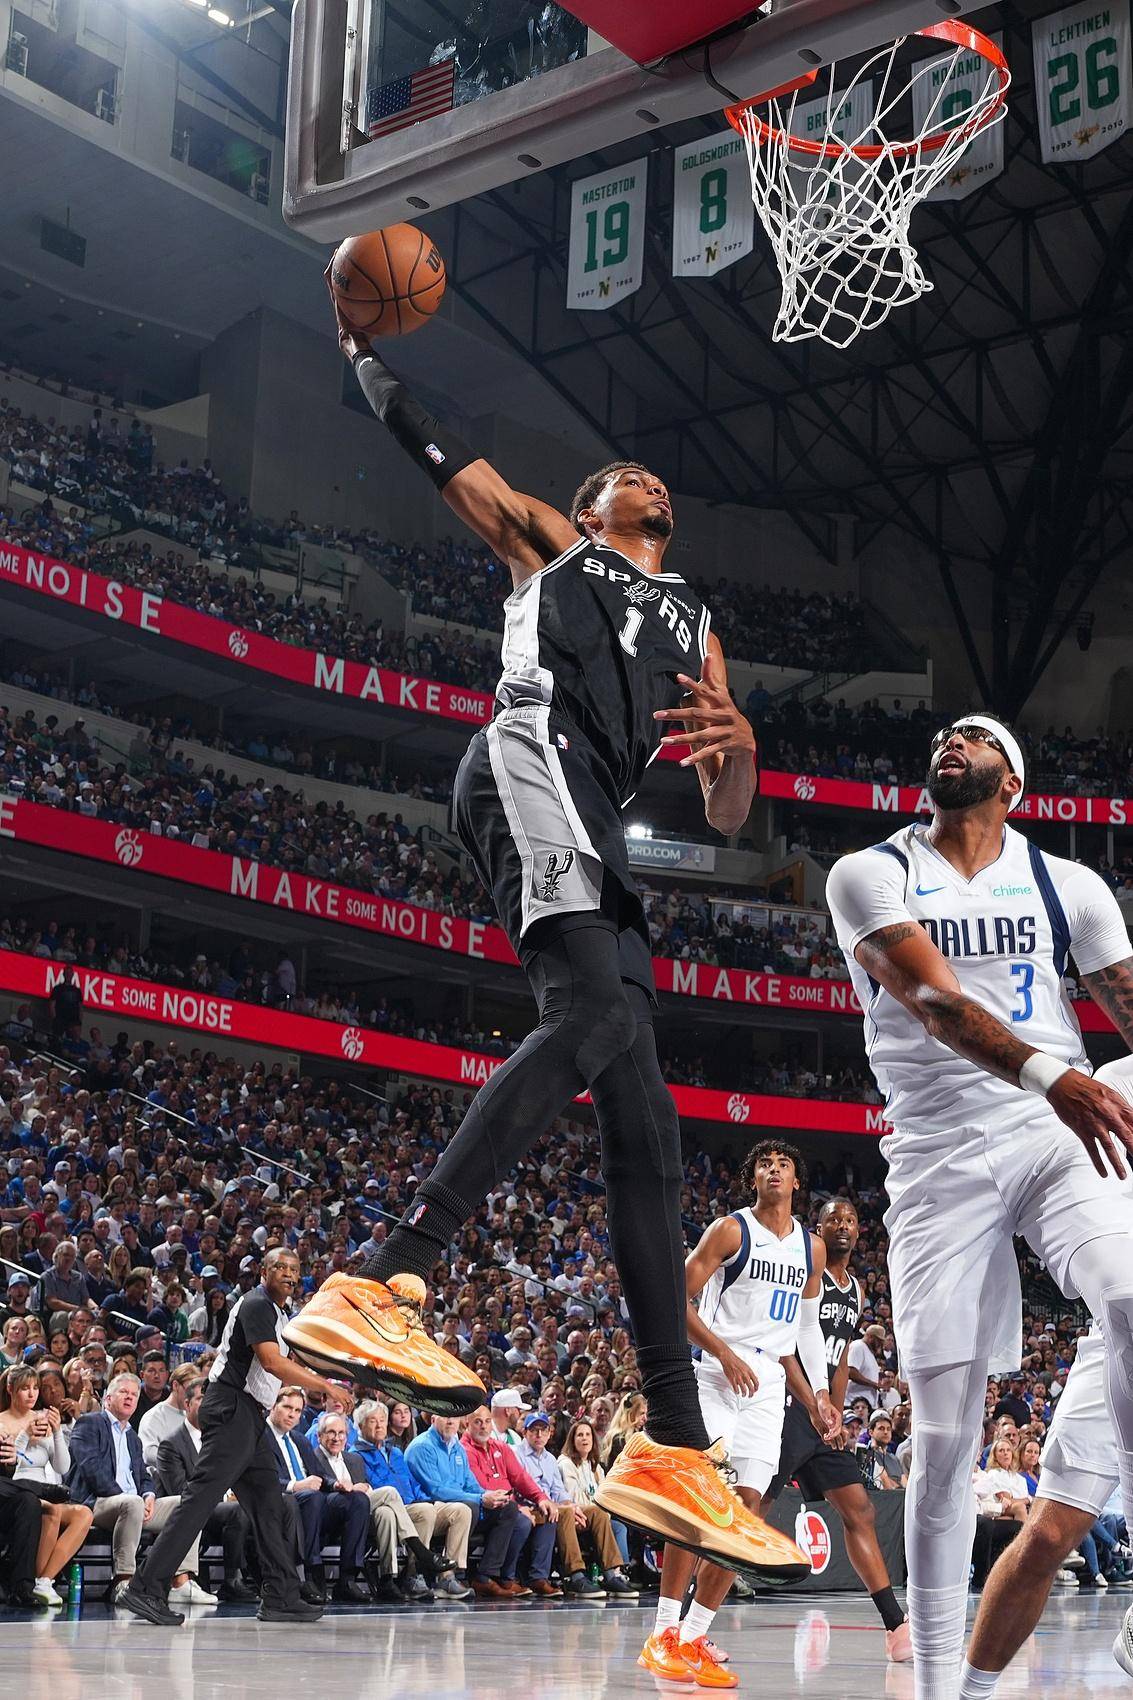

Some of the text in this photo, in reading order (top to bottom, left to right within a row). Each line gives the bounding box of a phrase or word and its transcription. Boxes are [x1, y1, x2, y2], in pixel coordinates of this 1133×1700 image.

[1051, 10, 1111, 46] LEHTINEN
[1048, 37, 1119, 127] 26
[1101, 119, 1123, 133] 2010
[582, 175, 636, 206] MASTERTON
[973, 162, 994, 175] 2010
[699, 167, 728, 234] 8
[584, 201, 630, 273] 19
[0, 551, 163, 635] ME NOISE
[618, 606, 645, 658] 1
[314, 653, 442, 713] MAKE
[450, 695, 486, 718] SOME
[872, 784, 935, 814] MA
[1037, 797, 1127, 825] NOIS
[628, 844, 681, 861] ORD.COM
[230, 856, 486, 959] MAKE SOME NOISE
[992, 884, 1032, 898] chime
[916, 915, 1037, 959] DALLAS
[671, 960, 781, 1004] MAKE
[788, 985, 824, 1003] SOME
[1008, 961, 1035, 1025] 3
[121, 986, 157, 1011] SOME
[162, 991, 233, 1031] NOISE
[749, 1258, 805, 1289] DALLAS
[769, 1288, 800, 1324] 00
